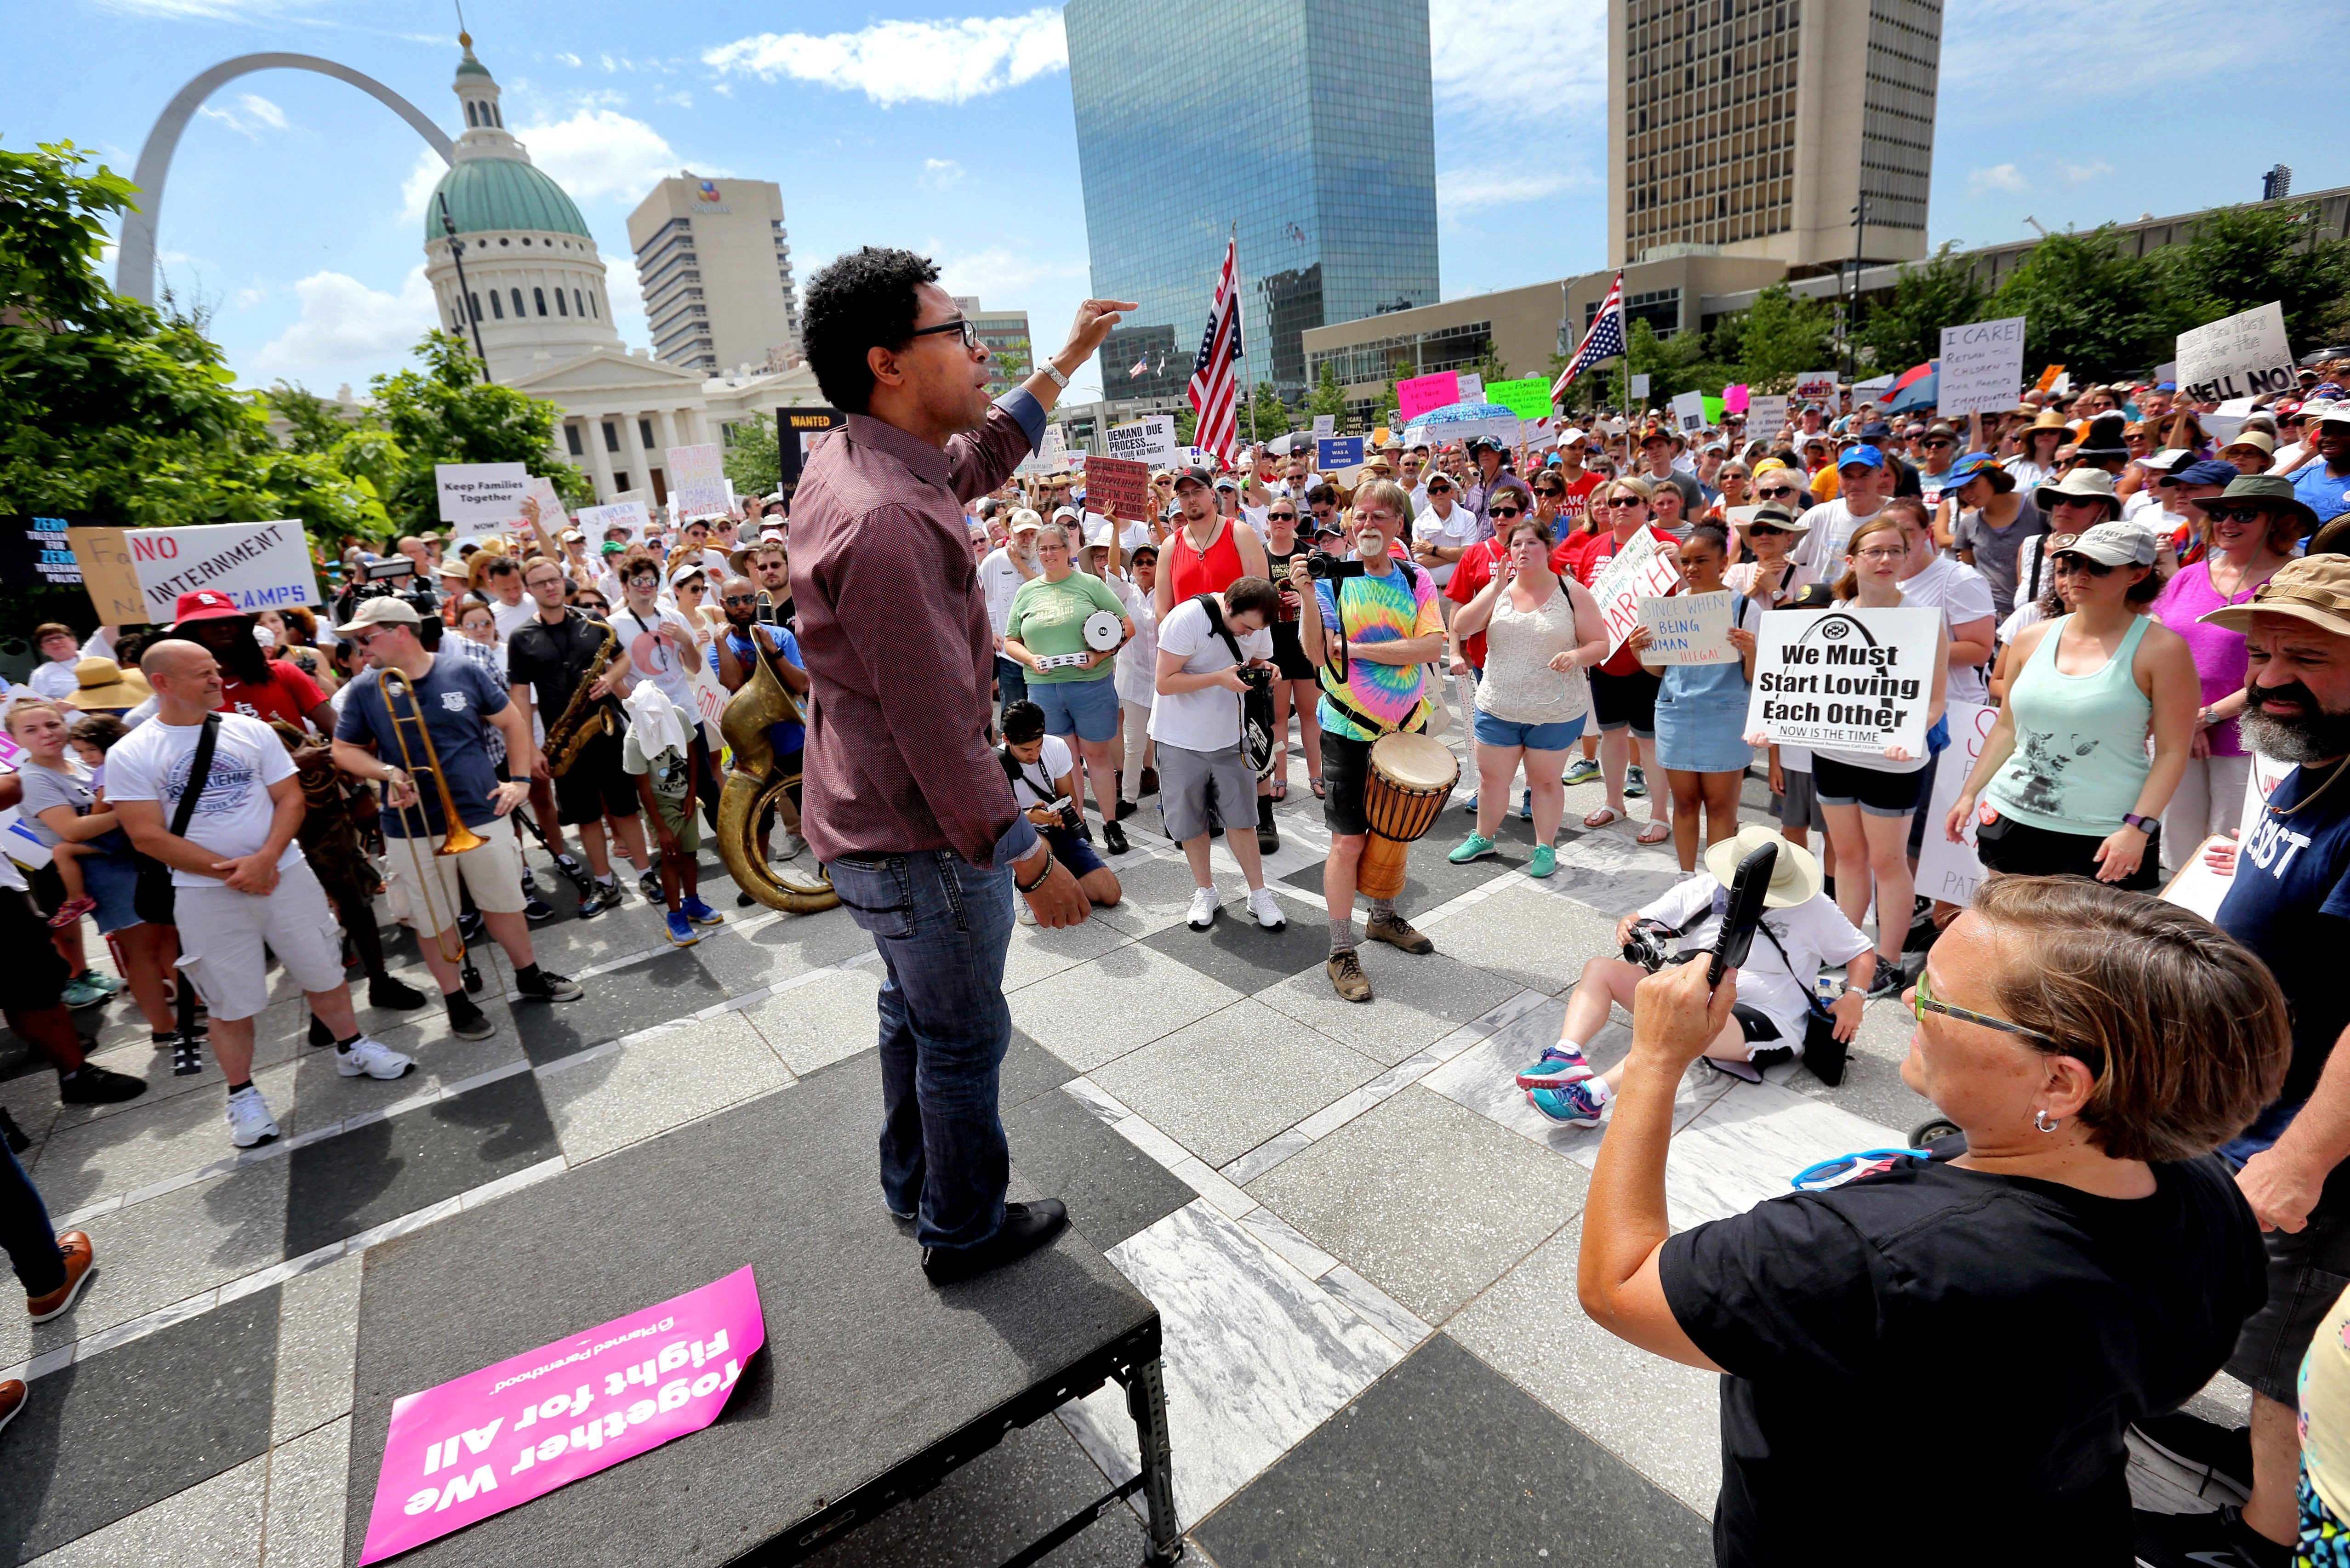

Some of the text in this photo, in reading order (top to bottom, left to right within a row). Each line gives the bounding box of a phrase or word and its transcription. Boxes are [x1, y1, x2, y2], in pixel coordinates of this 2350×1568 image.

[1946, 321, 2022, 346] I CARE!
[2185, 365, 2298, 403] HELL NO!
[790, 416, 830, 427] WANTED
[1107, 423, 1163, 441] DEMAND DUE
[1109, 438, 1156, 452] PROCESS...
[1119, 450, 1135, 458] YOUR
[1147, 445, 1165, 454] MIGHT
[1090, 460, 1101, 469] YOU
[1103, 462, 1114, 472] MAY
[1116, 464, 1126, 473] SAY
[445, 480, 523, 491] Keep Families
[677, 477, 722, 490] EDUCATE
[1089, 469, 1143, 490] Dreamer
[460, 493, 512, 504] Together
[1089, 487, 1105, 496] BUT
[1124, 491, 1142, 502] NOT
[1089, 497, 1102, 507] THE
[1126, 503, 1141, 513] ONE
[32, 517, 68, 531] ZERO
[45, 541, 66, 550] FOR
[132, 536, 179, 561] NO
[40, 550, 77, 563] ZERO
[147, 525, 283, 604] INTERNMENT
[1056, 606, 1074, 617] BAND
[1643, 595, 1725, 618] SINCE WHEN
[1660, 619, 1700, 634] BEING
[1782, 644, 1899, 665] We Must
[1760, 672, 1920, 699] Start Loving
[1763, 700, 1908, 728] Each Other
[1780, 725, 1879, 742] NOW IS THE TIME
[1031, 875, 1047, 889] REPEAL
[495, 1326, 656, 1393] Planned Parenthood
[423, 1328, 730, 1477] Fight for All
[404, 1358, 743, 1516] Together We
